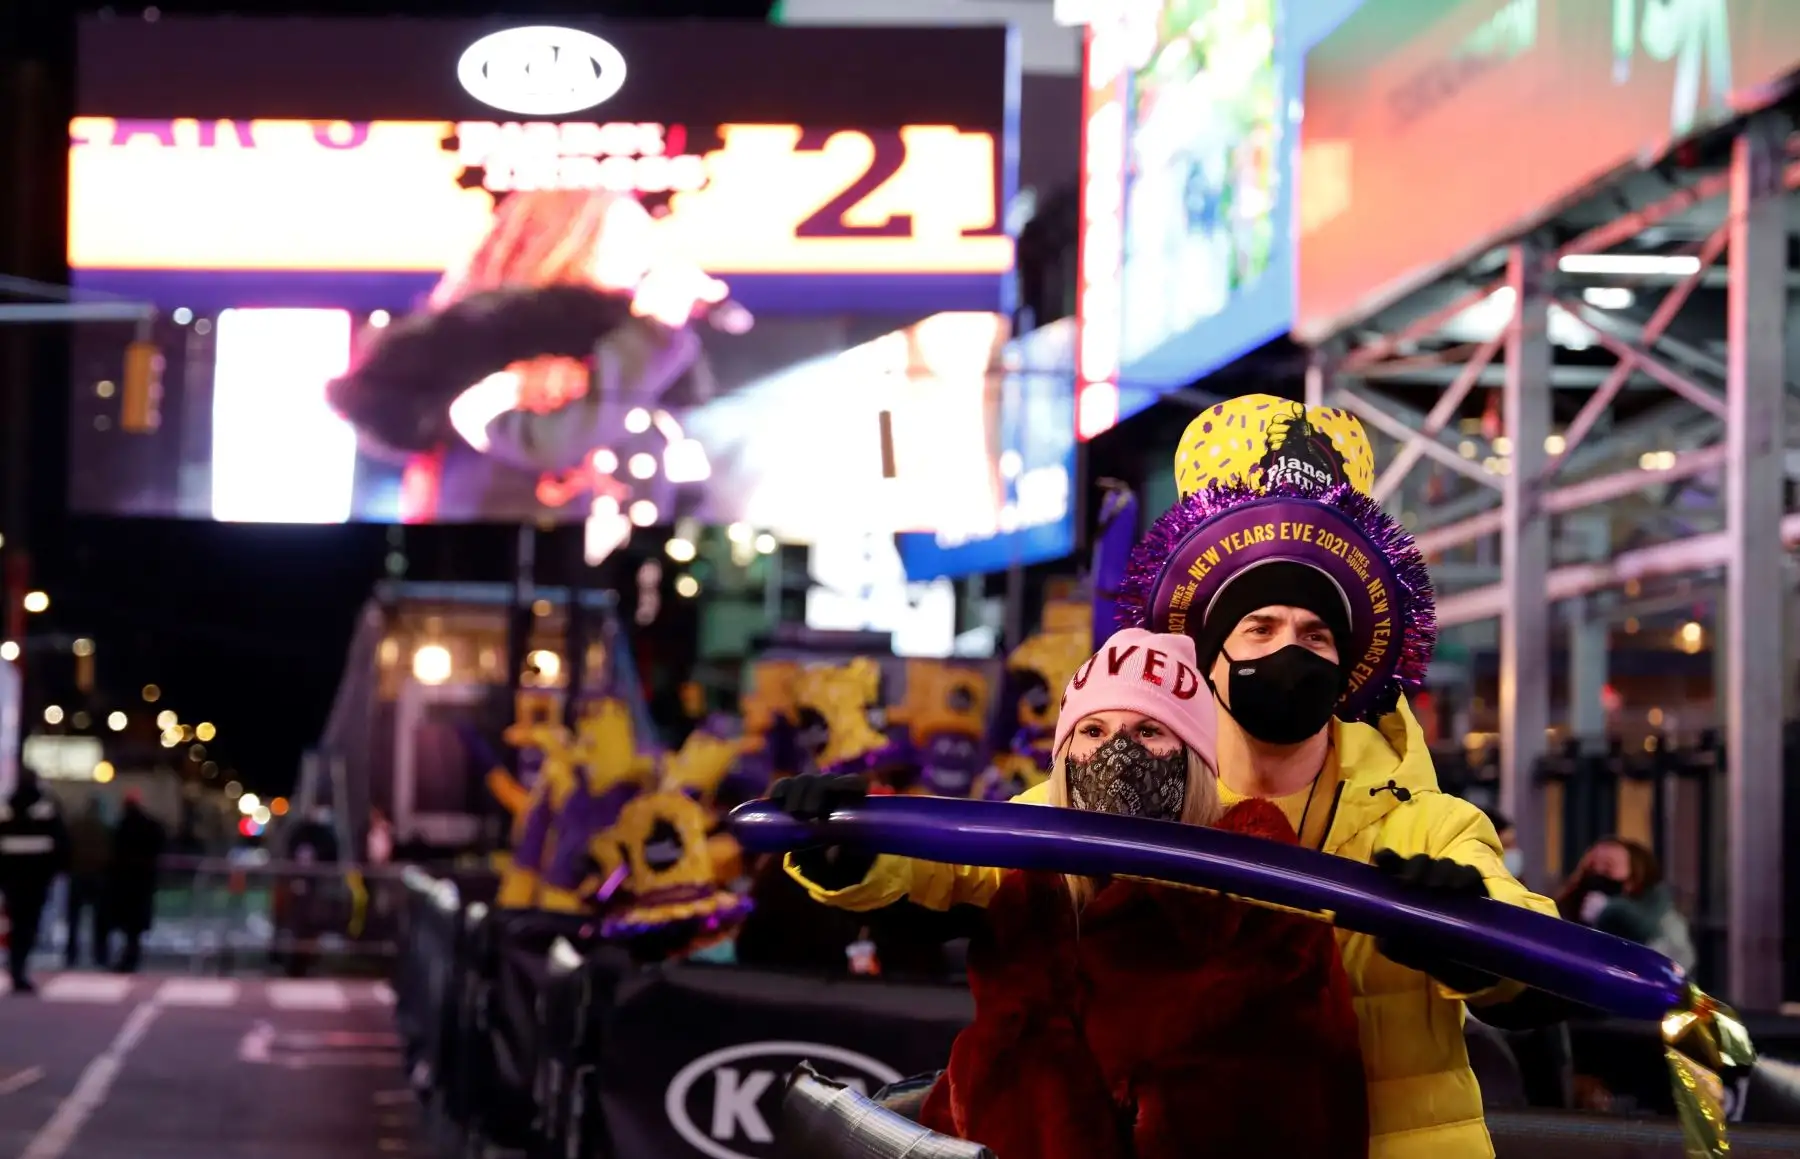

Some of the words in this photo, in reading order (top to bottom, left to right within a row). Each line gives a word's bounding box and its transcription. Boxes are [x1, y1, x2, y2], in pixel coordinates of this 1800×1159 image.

[1187, 546, 1221, 581] NEW
[1219, 523, 1276, 555] YEARS
[1280, 522, 1314, 542] EVE
[1315, 528, 1349, 558] 2021
[1350, 546, 1370, 568] TIMES
[1346, 554, 1370, 582] SQUARE
[1169, 584, 1186, 608] TIMES
[1180, 580, 1199, 610] SQUARE
[1366, 577, 1389, 614] NEW
[1168, 613, 1186, 635] 021
[1364, 617, 1392, 664] YEARS
[1061, 645, 1199, 711] OVED
